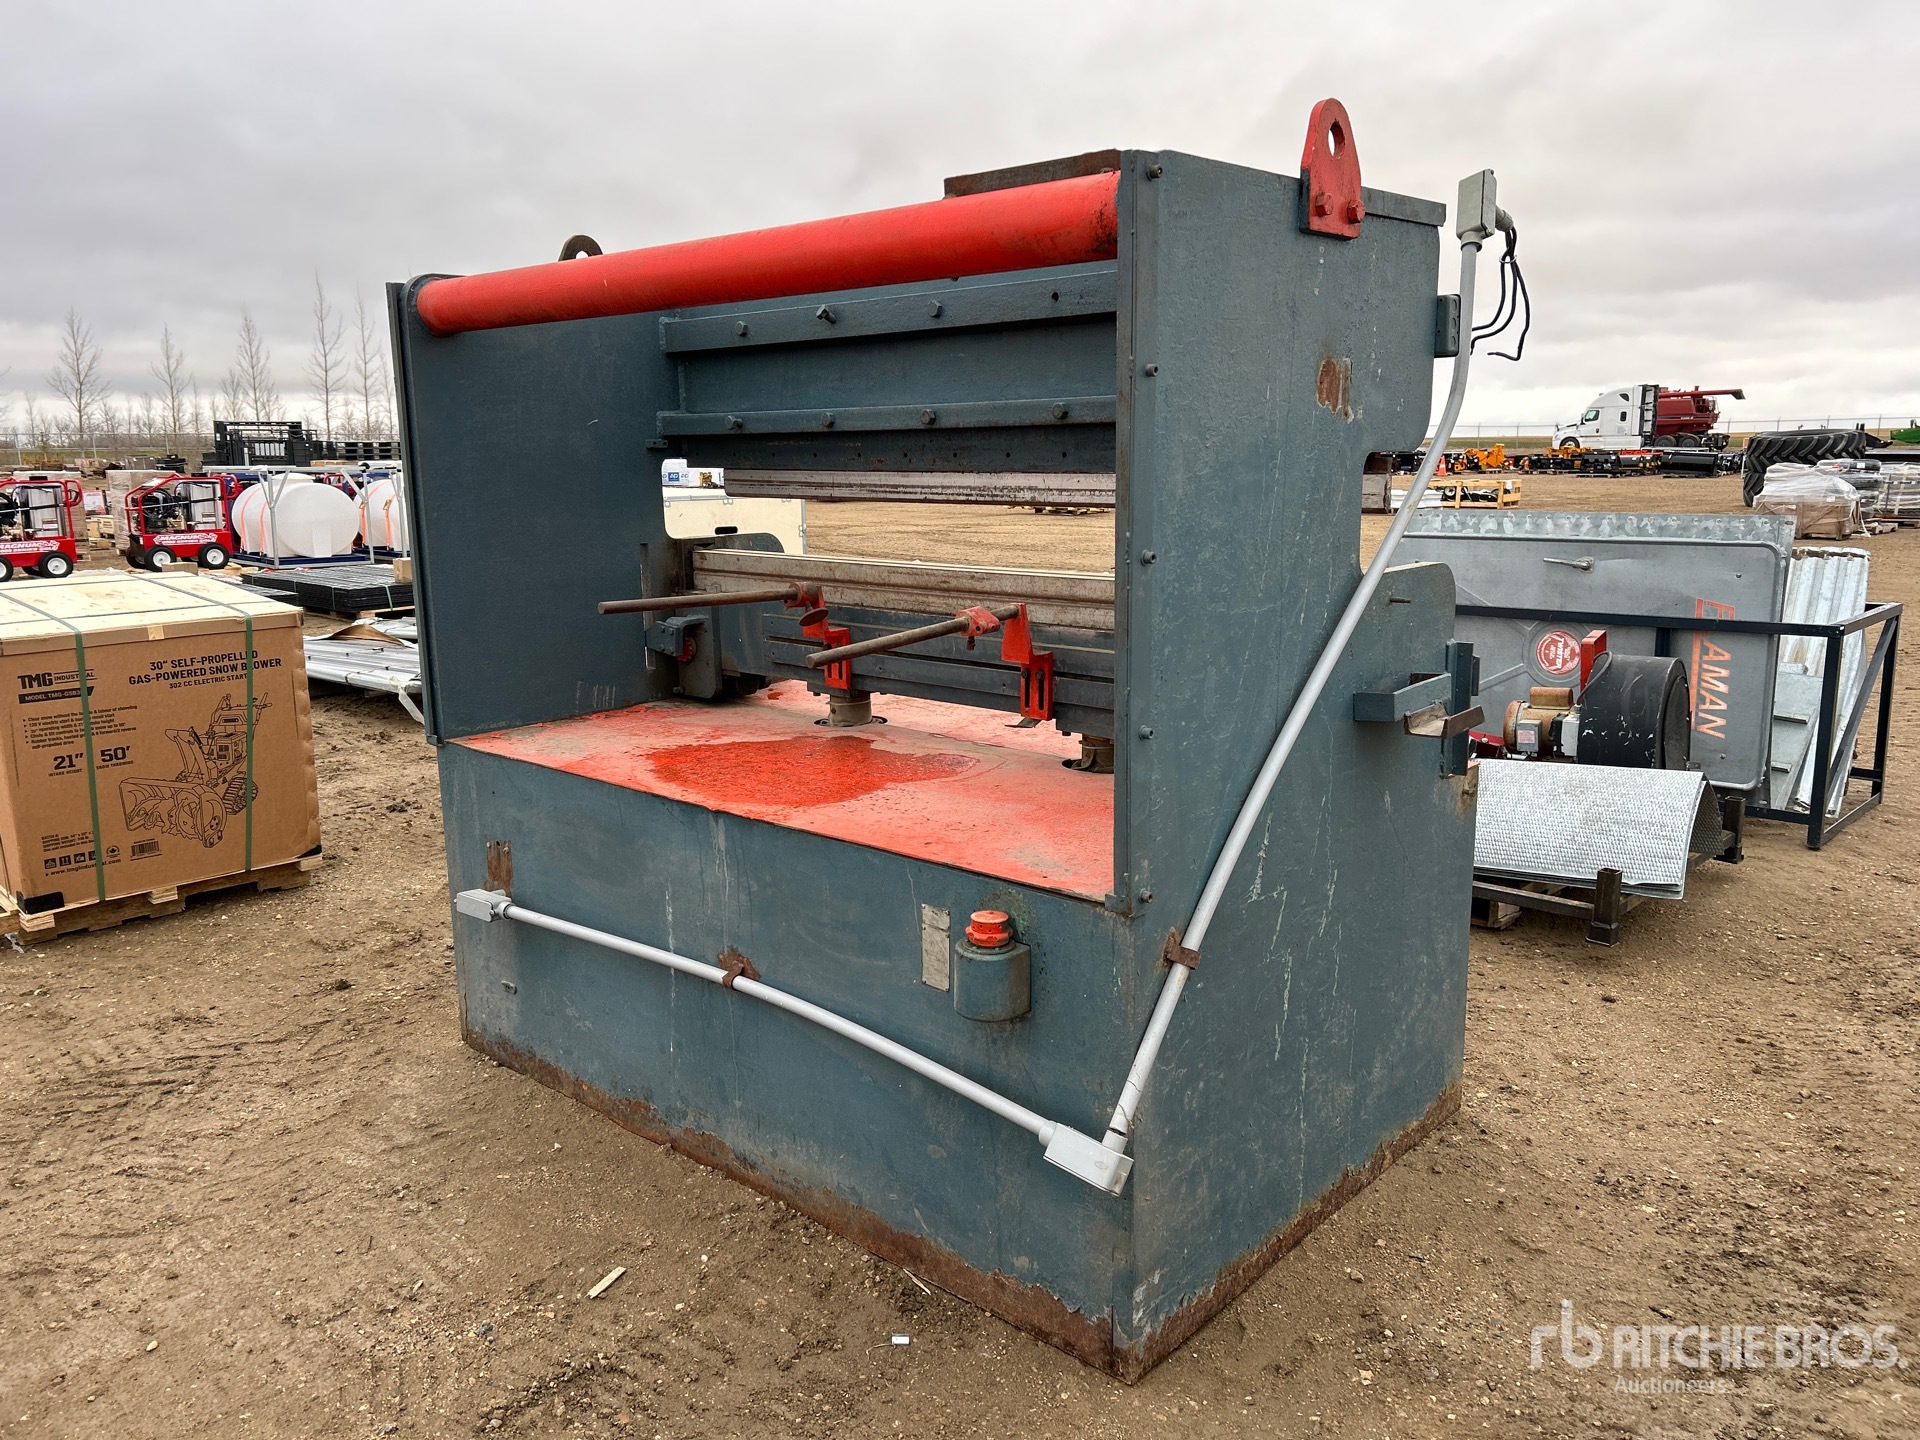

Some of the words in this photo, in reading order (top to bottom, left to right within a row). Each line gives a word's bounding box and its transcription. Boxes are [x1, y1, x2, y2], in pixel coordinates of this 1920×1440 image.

[149, 660, 168, 671] 30"
[171, 650, 259, 669] SELF-PROPELLD
[128, 668, 207, 685] GAS-POWERED
[209, 663, 239, 675] SNOW
[241, 658, 282, 671] BOWER
[1696, 601, 1735, 739] FAMAN
[17, 672, 54, 690] TMG
[54, 672, 95, 682] INDUSTAL
[193, 676, 226, 686] ELECTRIC
[226, 673, 248, 681] START
[53, 753, 84, 770] 21"
[100, 746, 131, 763] 50'
